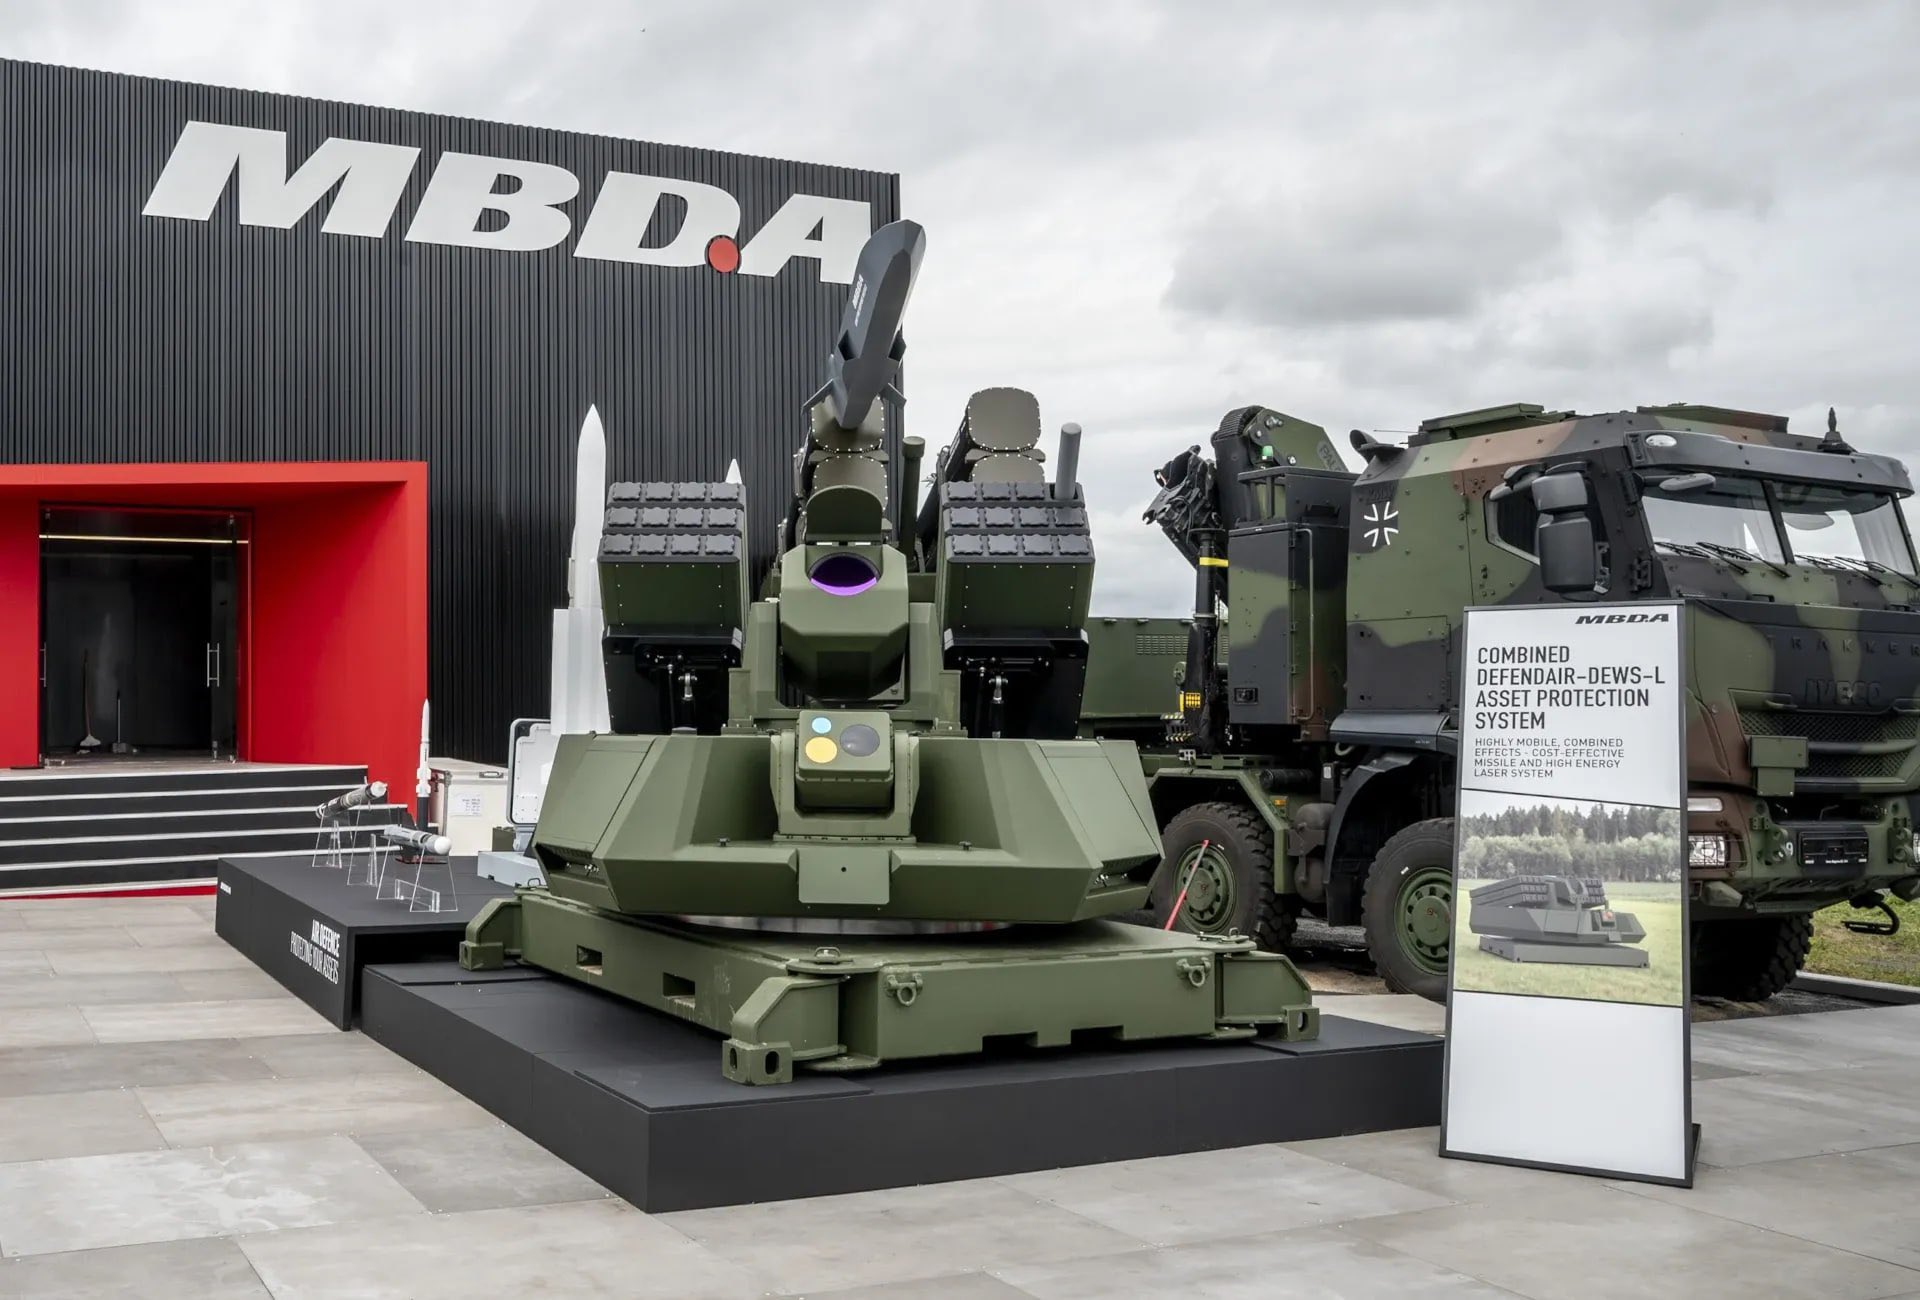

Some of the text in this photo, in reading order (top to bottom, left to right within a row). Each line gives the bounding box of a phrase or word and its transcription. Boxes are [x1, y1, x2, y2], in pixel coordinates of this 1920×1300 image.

[1478, 646, 1570, 664] COMBINED
[1477, 666, 1666, 686] DEFENDAIR-DEWS-L
[1475, 688, 1649, 707] ASSET PROTECTION
[1805, 678, 1881, 706] IVECO
[1475, 711, 1545, 730] SYSTEM
[1475, 738, 1624, 748] HIGHLY MOBILE, COMBINED
[1474, 748, 1521, 757] EFFECTS
[1532, 748, 1624, 758] COST-EFFECTIVE
[1474, 758, 1620, 768] MISSILE AND HIGH ENERGY
[1474, 768, 1553, 778] LASER SYSTEM
